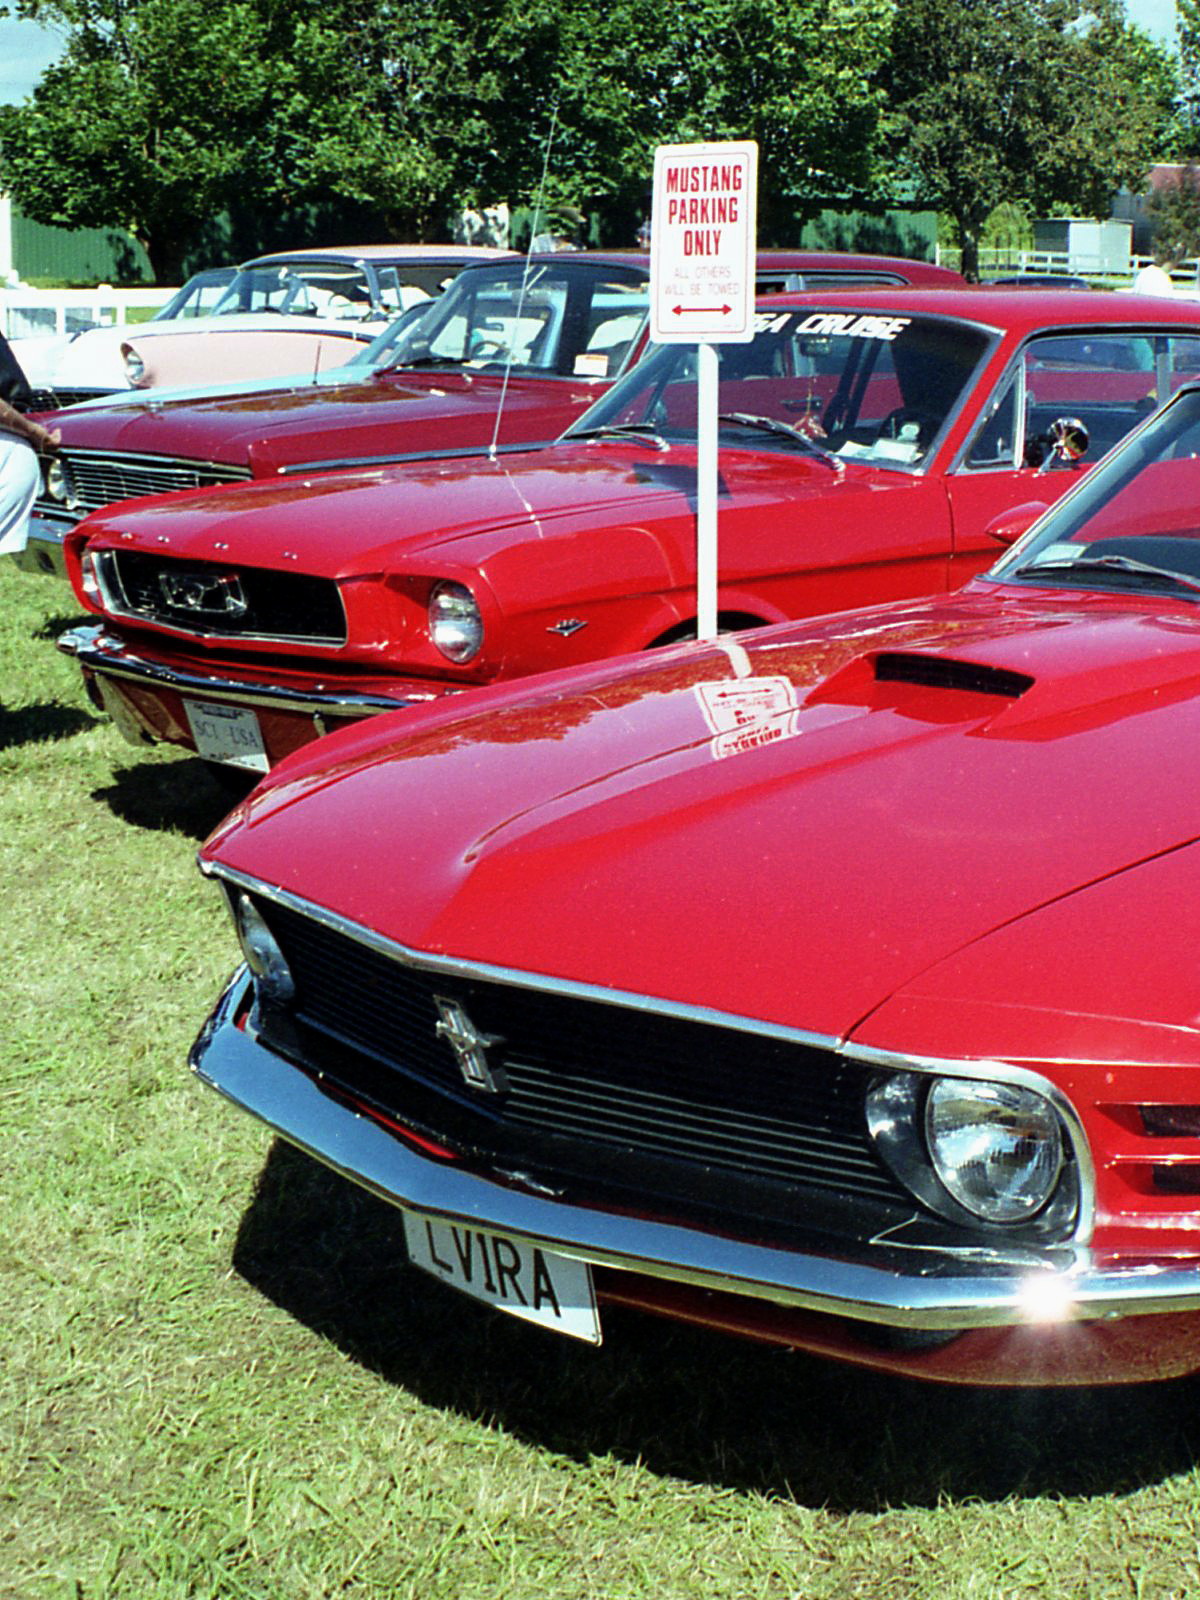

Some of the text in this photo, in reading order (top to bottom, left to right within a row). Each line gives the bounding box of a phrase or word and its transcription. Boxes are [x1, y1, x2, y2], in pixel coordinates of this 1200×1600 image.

[666, 165, 742, 193] MUSTANG
[668, 197, 738, 224] PARKING
[683, 230, 721, 256] ONLY
[673, 265, 732, 279] ALL OTHERS
[664, 282, 740, 296] WILL BE TOWED
[795, 313, 912, 341] CRUISE
